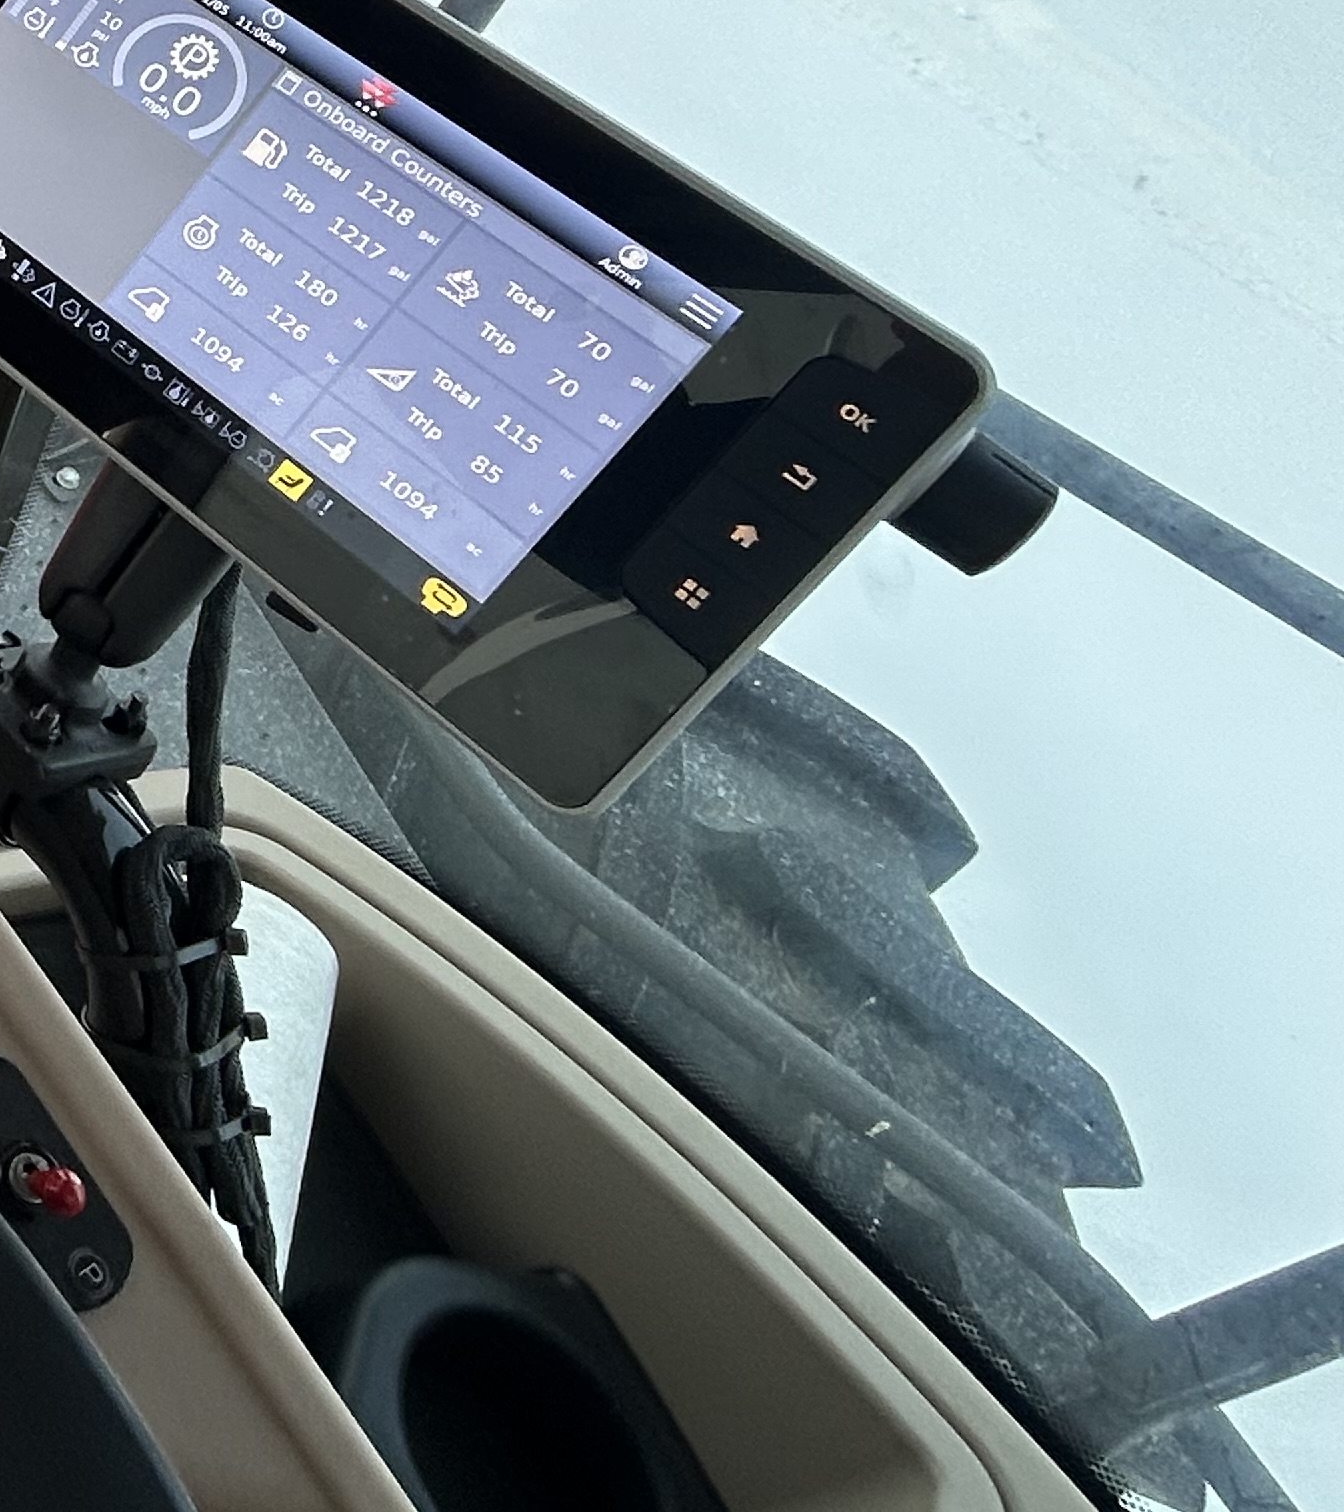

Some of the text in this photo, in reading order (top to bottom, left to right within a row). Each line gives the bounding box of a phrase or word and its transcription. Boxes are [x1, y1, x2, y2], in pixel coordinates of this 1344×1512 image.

[99, 10, 124, 31] 10
[235, 15, 288, 55] 11:00am
[139, 62, 202, 116] 0.0
[140, 95, 171, 120] mph
[303, 90, 485, 220] Onboard Counters
[305, 143, 351, 182] Total
[356, 180, 416, 227] 1218
[280, 182, 316, 216] Trip
[327, 215, 387, 260] 1217
[215, 264, 249, 299] Trip
[266, 304, 311, 342] 126
[238, 227, 284, 268] Total
[294, 269, 340, 308] 180
[597, 256, 644, 290] Admin
[189, 326, 246, 374] 1094
[504, 279, 557, 324] Total
[577, 330, 613, 363] 70
[479, 321, 518, 357] Trip
[545, 367, 581, 400] 70
[407, 406, 444, 443] Trip
[469, 453, 505, 486] 85
[432, 366, 482, 411] Total
[493, 413, 543, 456] 115
[839, 403, 878, 434] OK
[379, 469, 440, 522] 1094
